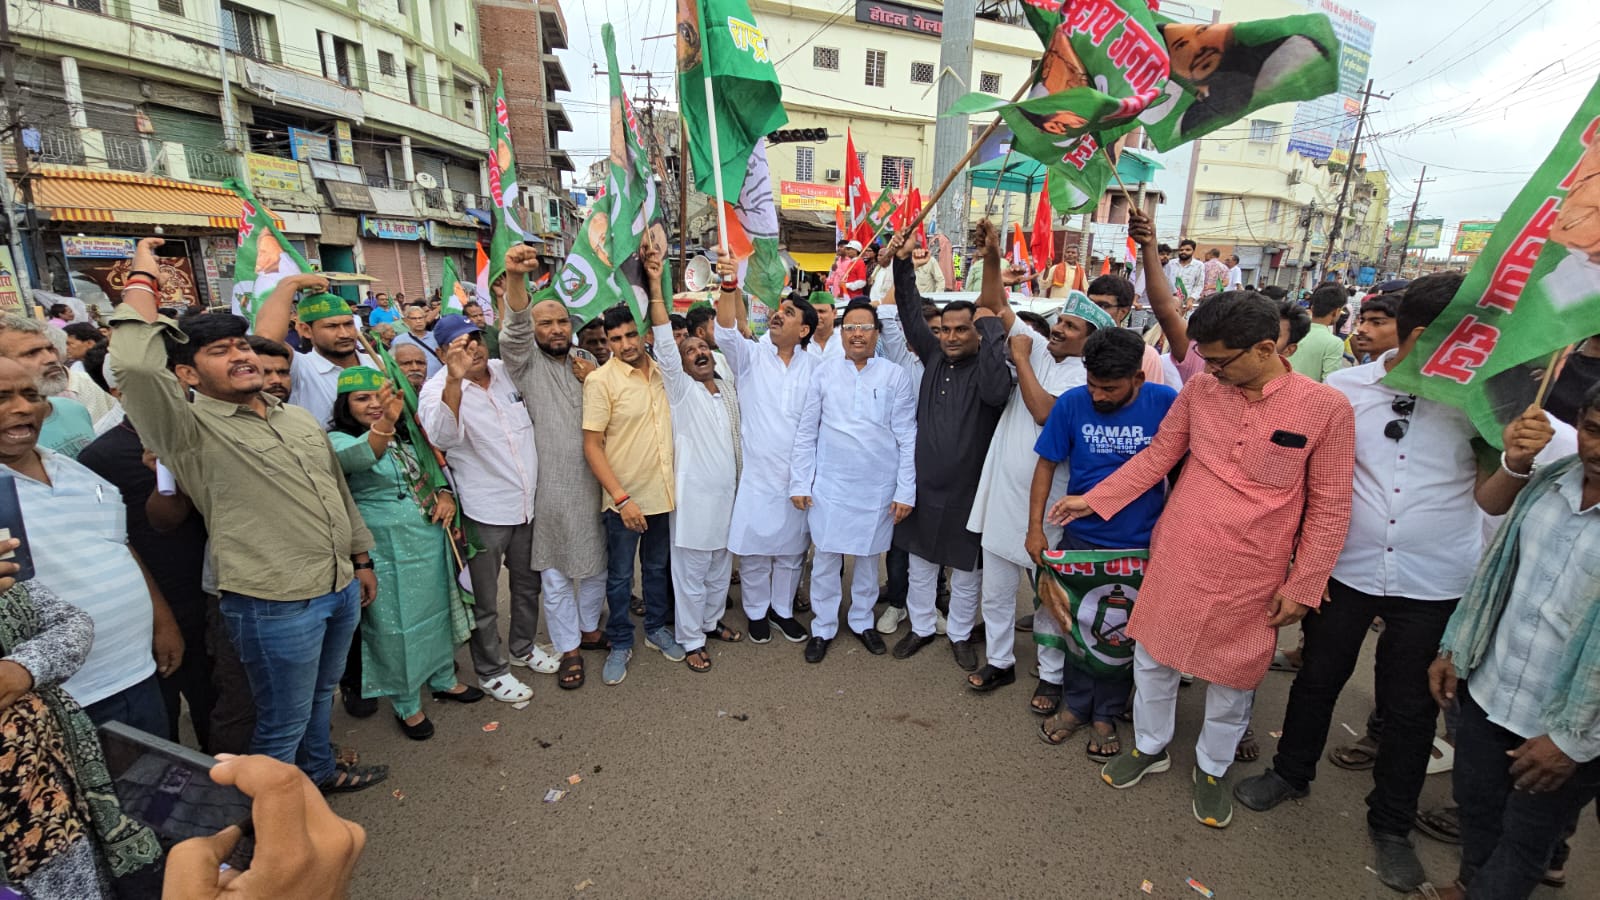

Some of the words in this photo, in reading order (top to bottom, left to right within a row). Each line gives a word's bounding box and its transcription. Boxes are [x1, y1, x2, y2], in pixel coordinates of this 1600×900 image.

[869, 6, 909, 26] होटल
[1081, 423, 1144, 438] QAMAR
[1083, 435, 1142, 446] TRADERS
